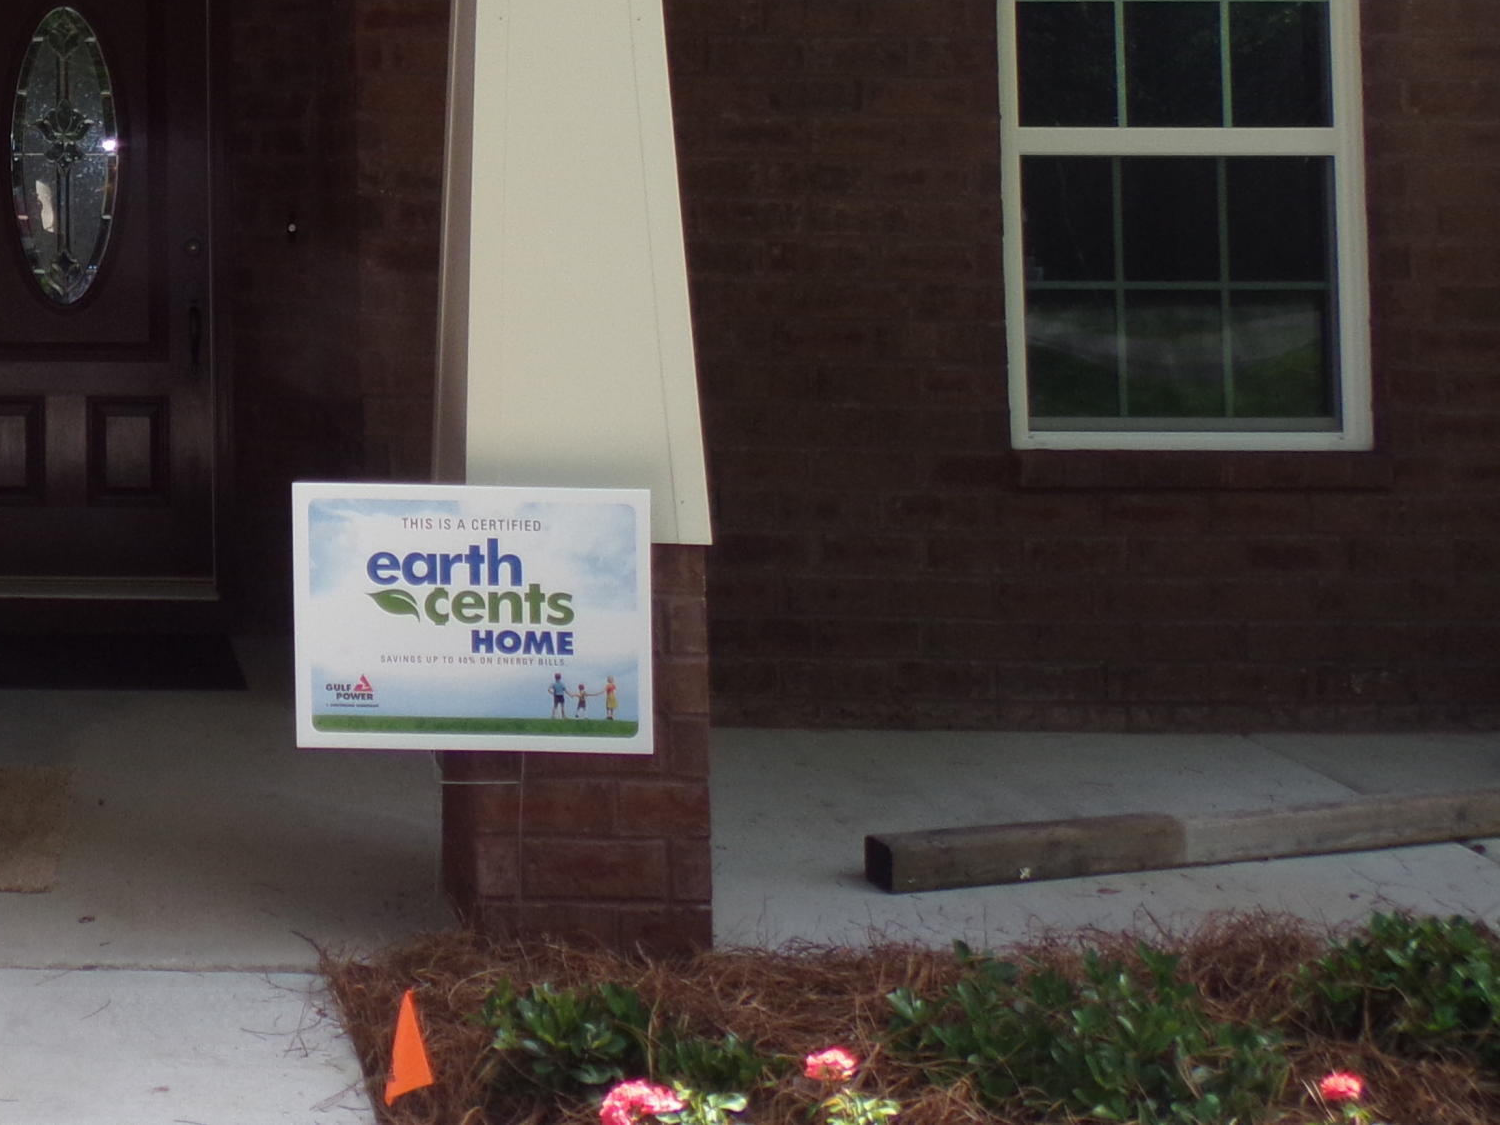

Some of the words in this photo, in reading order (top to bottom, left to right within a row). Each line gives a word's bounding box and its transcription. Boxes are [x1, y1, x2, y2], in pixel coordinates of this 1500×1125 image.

[401, 517, 433, 530] THIS
[438, 518, 451, 530] IS
[457, 519, 466, 531] A
[471, 519, 542, 532] CERTIFIED
[366, 538, 523, 587] earth
[470, 630, 575, 656] HOME
[380, 655, 423, 664] SAVINGS
[426, 656, 438, 664] UP
[443, 656, 454, 664] TO
[480, 657, 493, 665] ON
[497, 657, 534, 666] ENERGY
[325, 683, 351, 692] GULF
[336, 692, 374, 701] POWER
